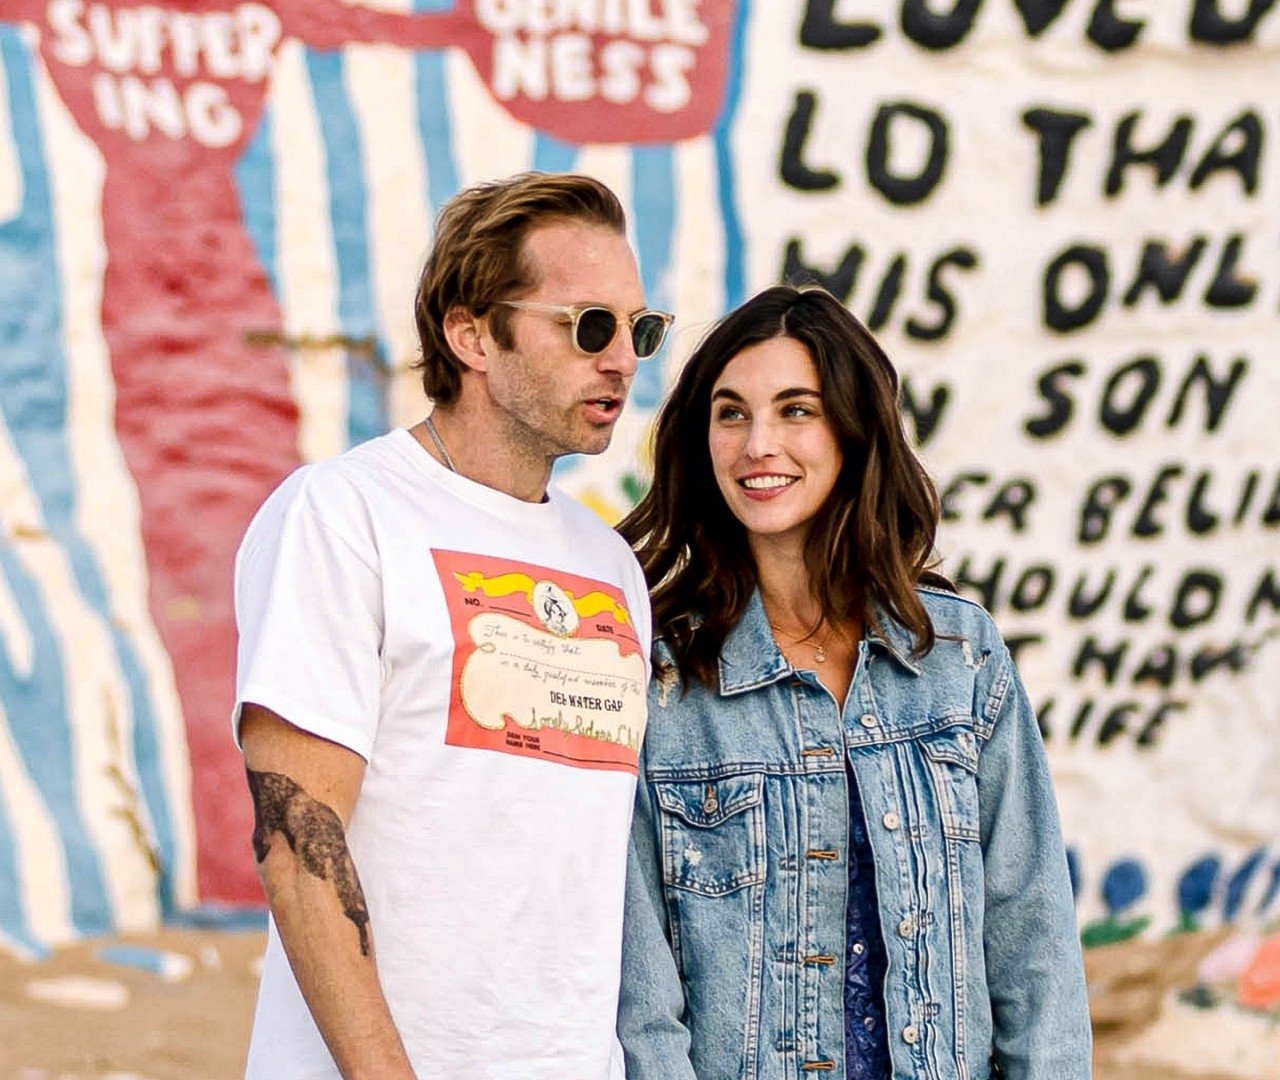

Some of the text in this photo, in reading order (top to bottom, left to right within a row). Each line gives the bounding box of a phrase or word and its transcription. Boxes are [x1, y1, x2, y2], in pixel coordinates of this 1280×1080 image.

[46, 0, 282, 83] SUFFER
[490, 33, 697, 114] NESS
[92, 71, 243, 148] ING
[790, 236, 982, 342] HIS
[1023, 353, 1250, 434] SON
[952, 551, 1226, 632] HOULD
[568, 694, 603, 712] WATER
[604, 698, 625, 713] GAP
